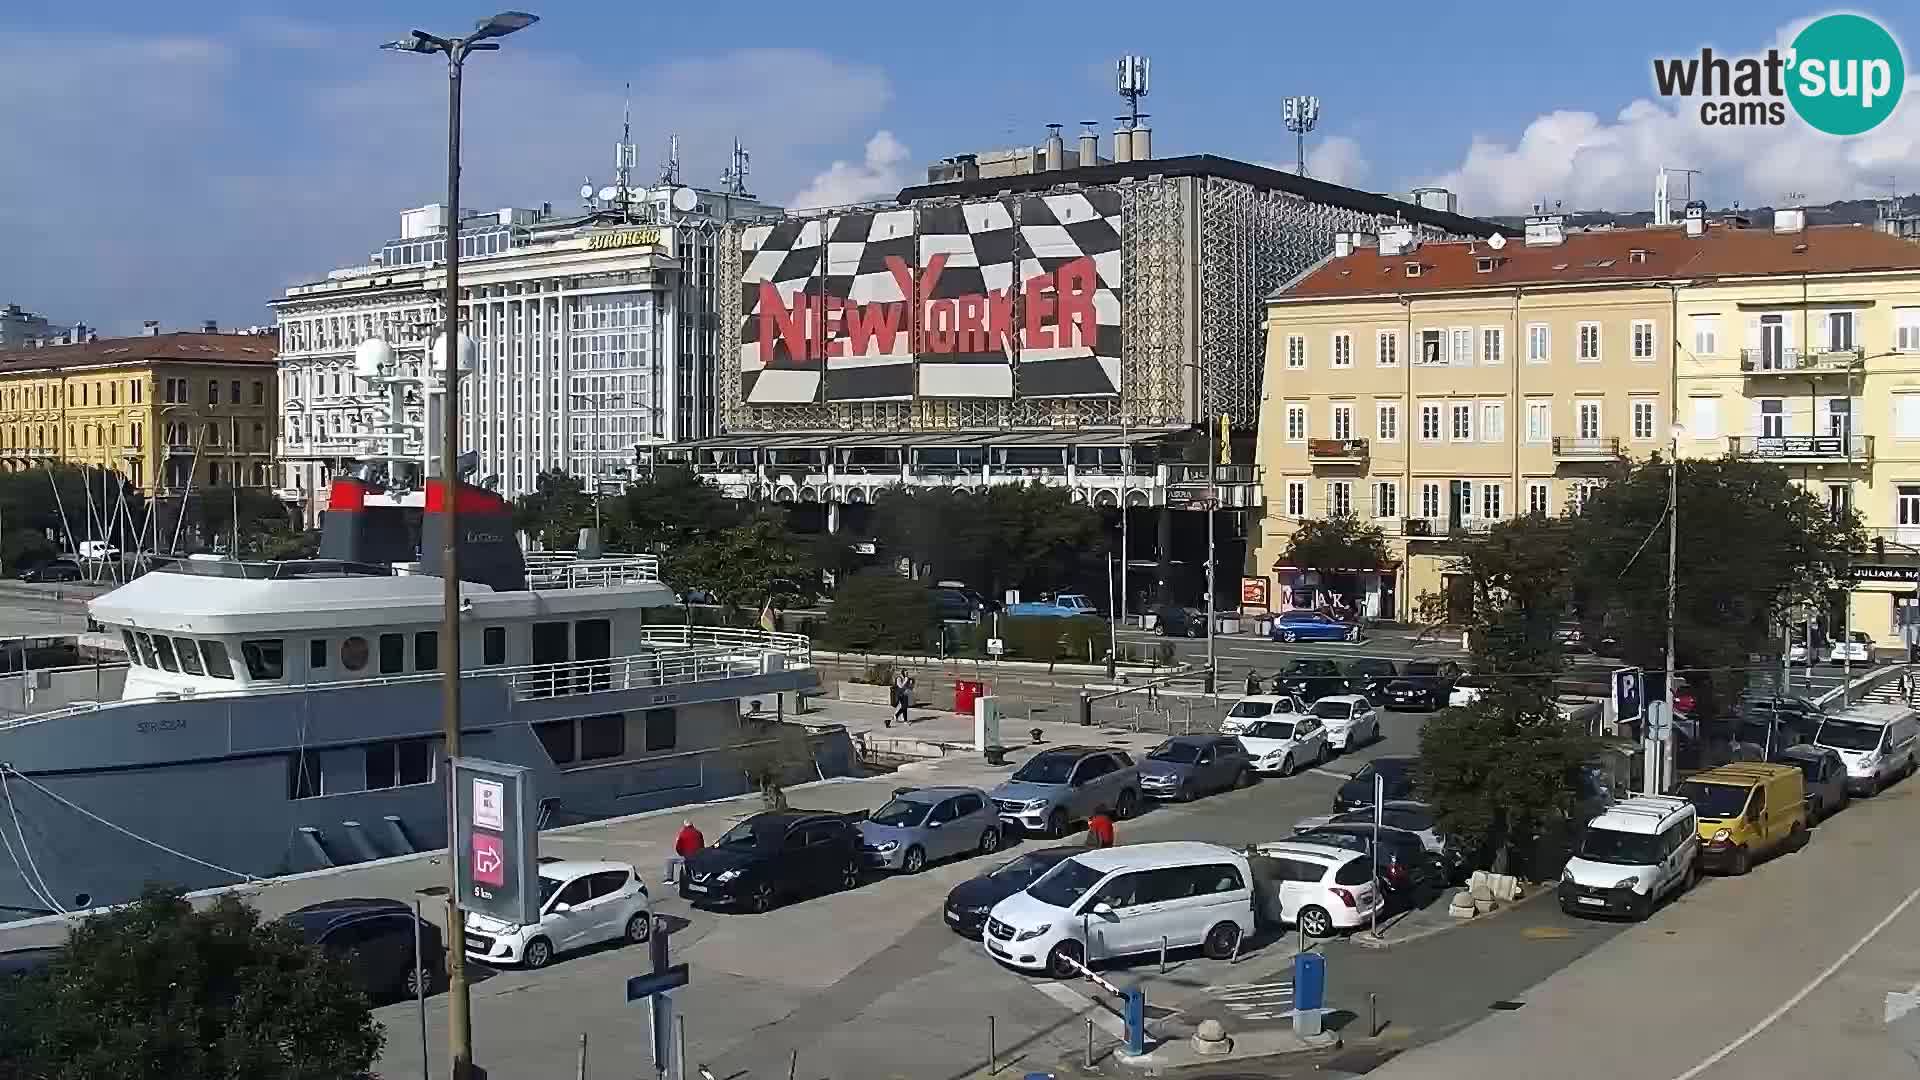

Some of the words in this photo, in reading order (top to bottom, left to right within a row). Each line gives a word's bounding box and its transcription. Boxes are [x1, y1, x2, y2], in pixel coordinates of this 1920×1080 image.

[759, 277, 902, 362] NEW
[885, 252, 1097, 354] YORKER
[1854, 569, 1901, 578] JULIANA
